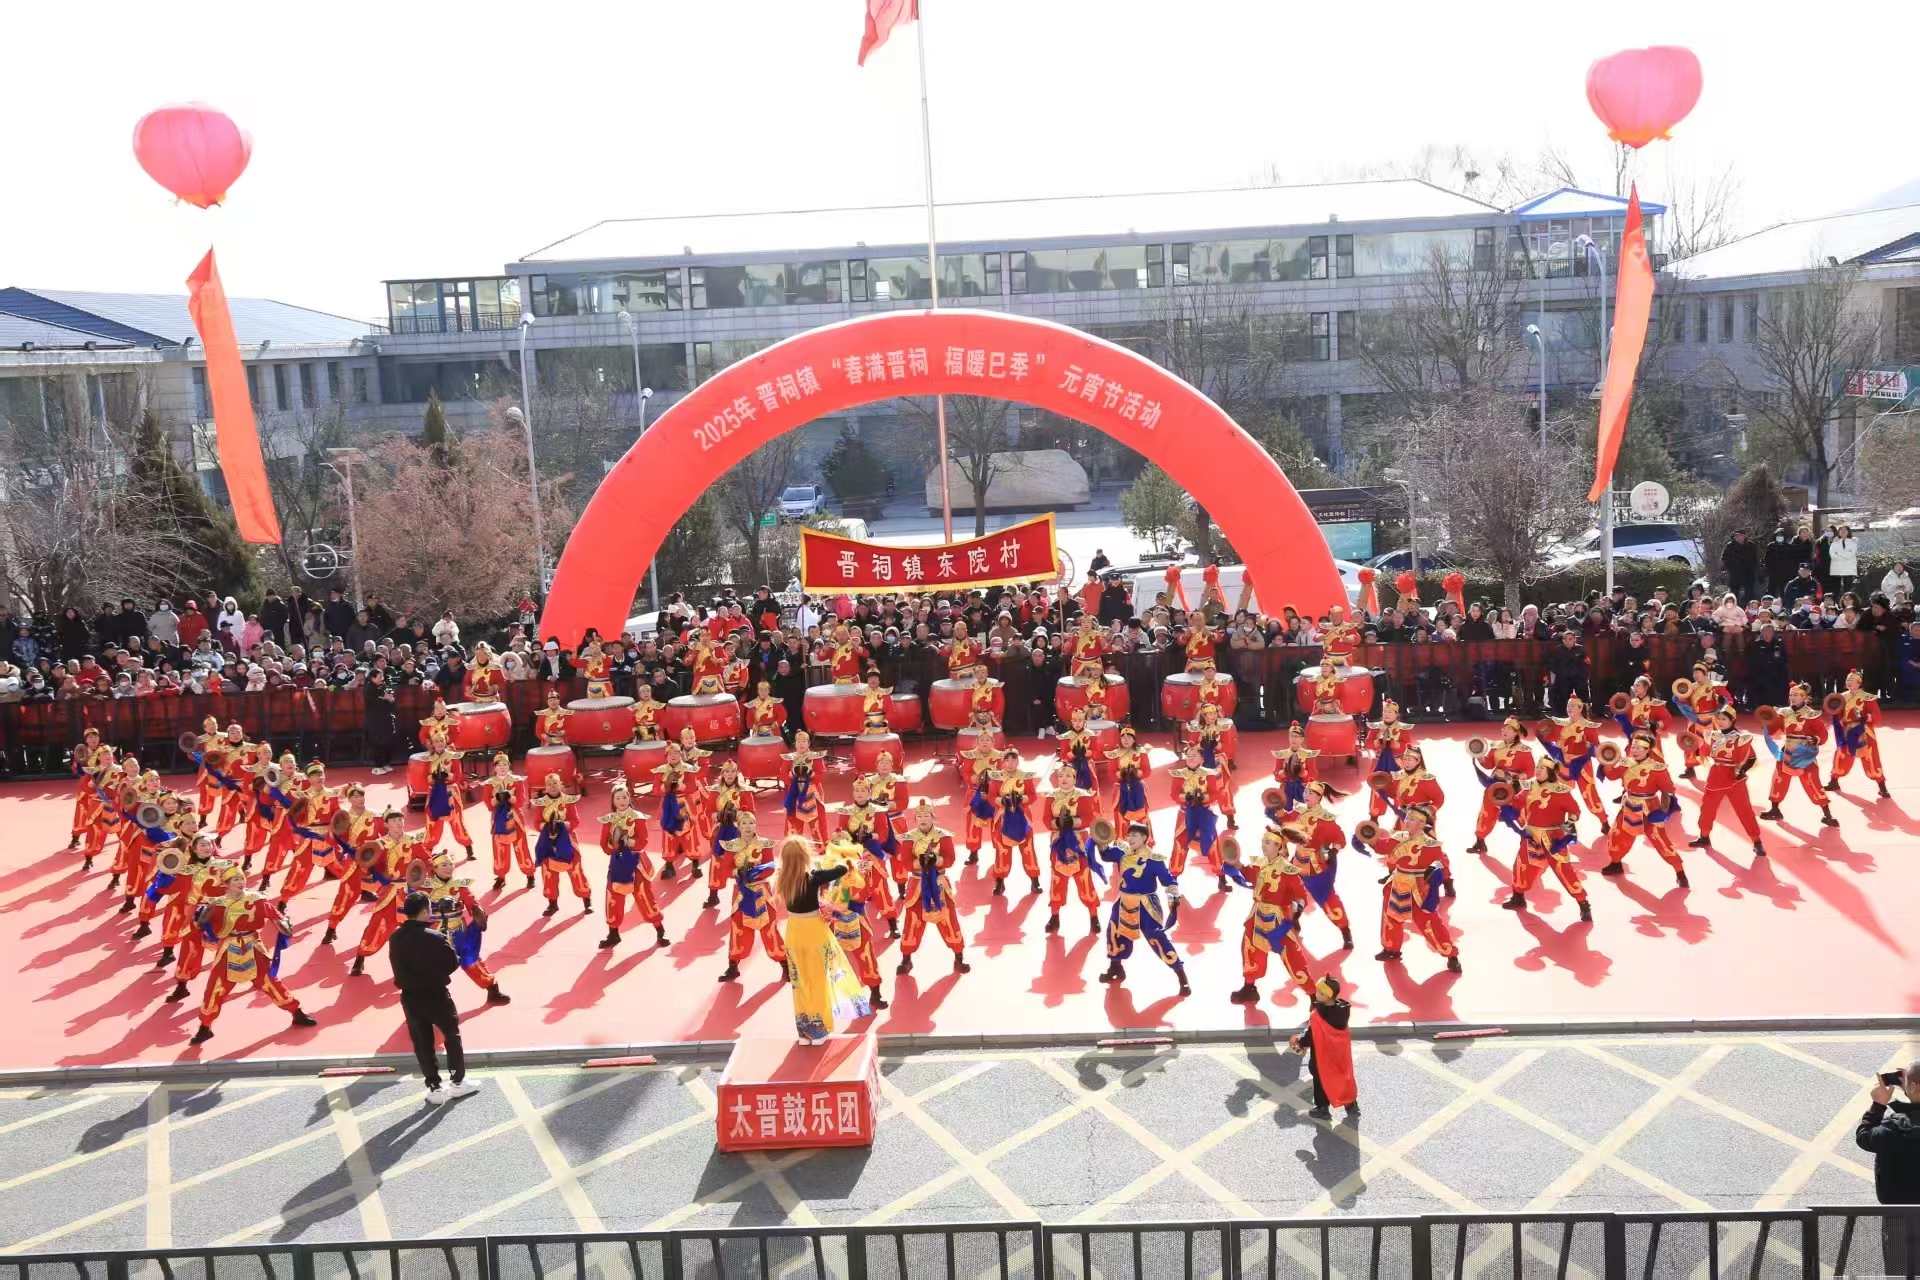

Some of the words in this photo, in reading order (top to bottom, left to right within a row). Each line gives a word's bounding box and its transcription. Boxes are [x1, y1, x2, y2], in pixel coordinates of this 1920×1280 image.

[693, 395, 757, 452] 2025年
[756, 366, 822, 413] 晋祠镇
[1058, 364, 1162, 431] 元宵节活动
[836, 537, 1021, 580] 晋祠镇东院村
[729, 1091, 861, 1138] 太晋鼓乐团
